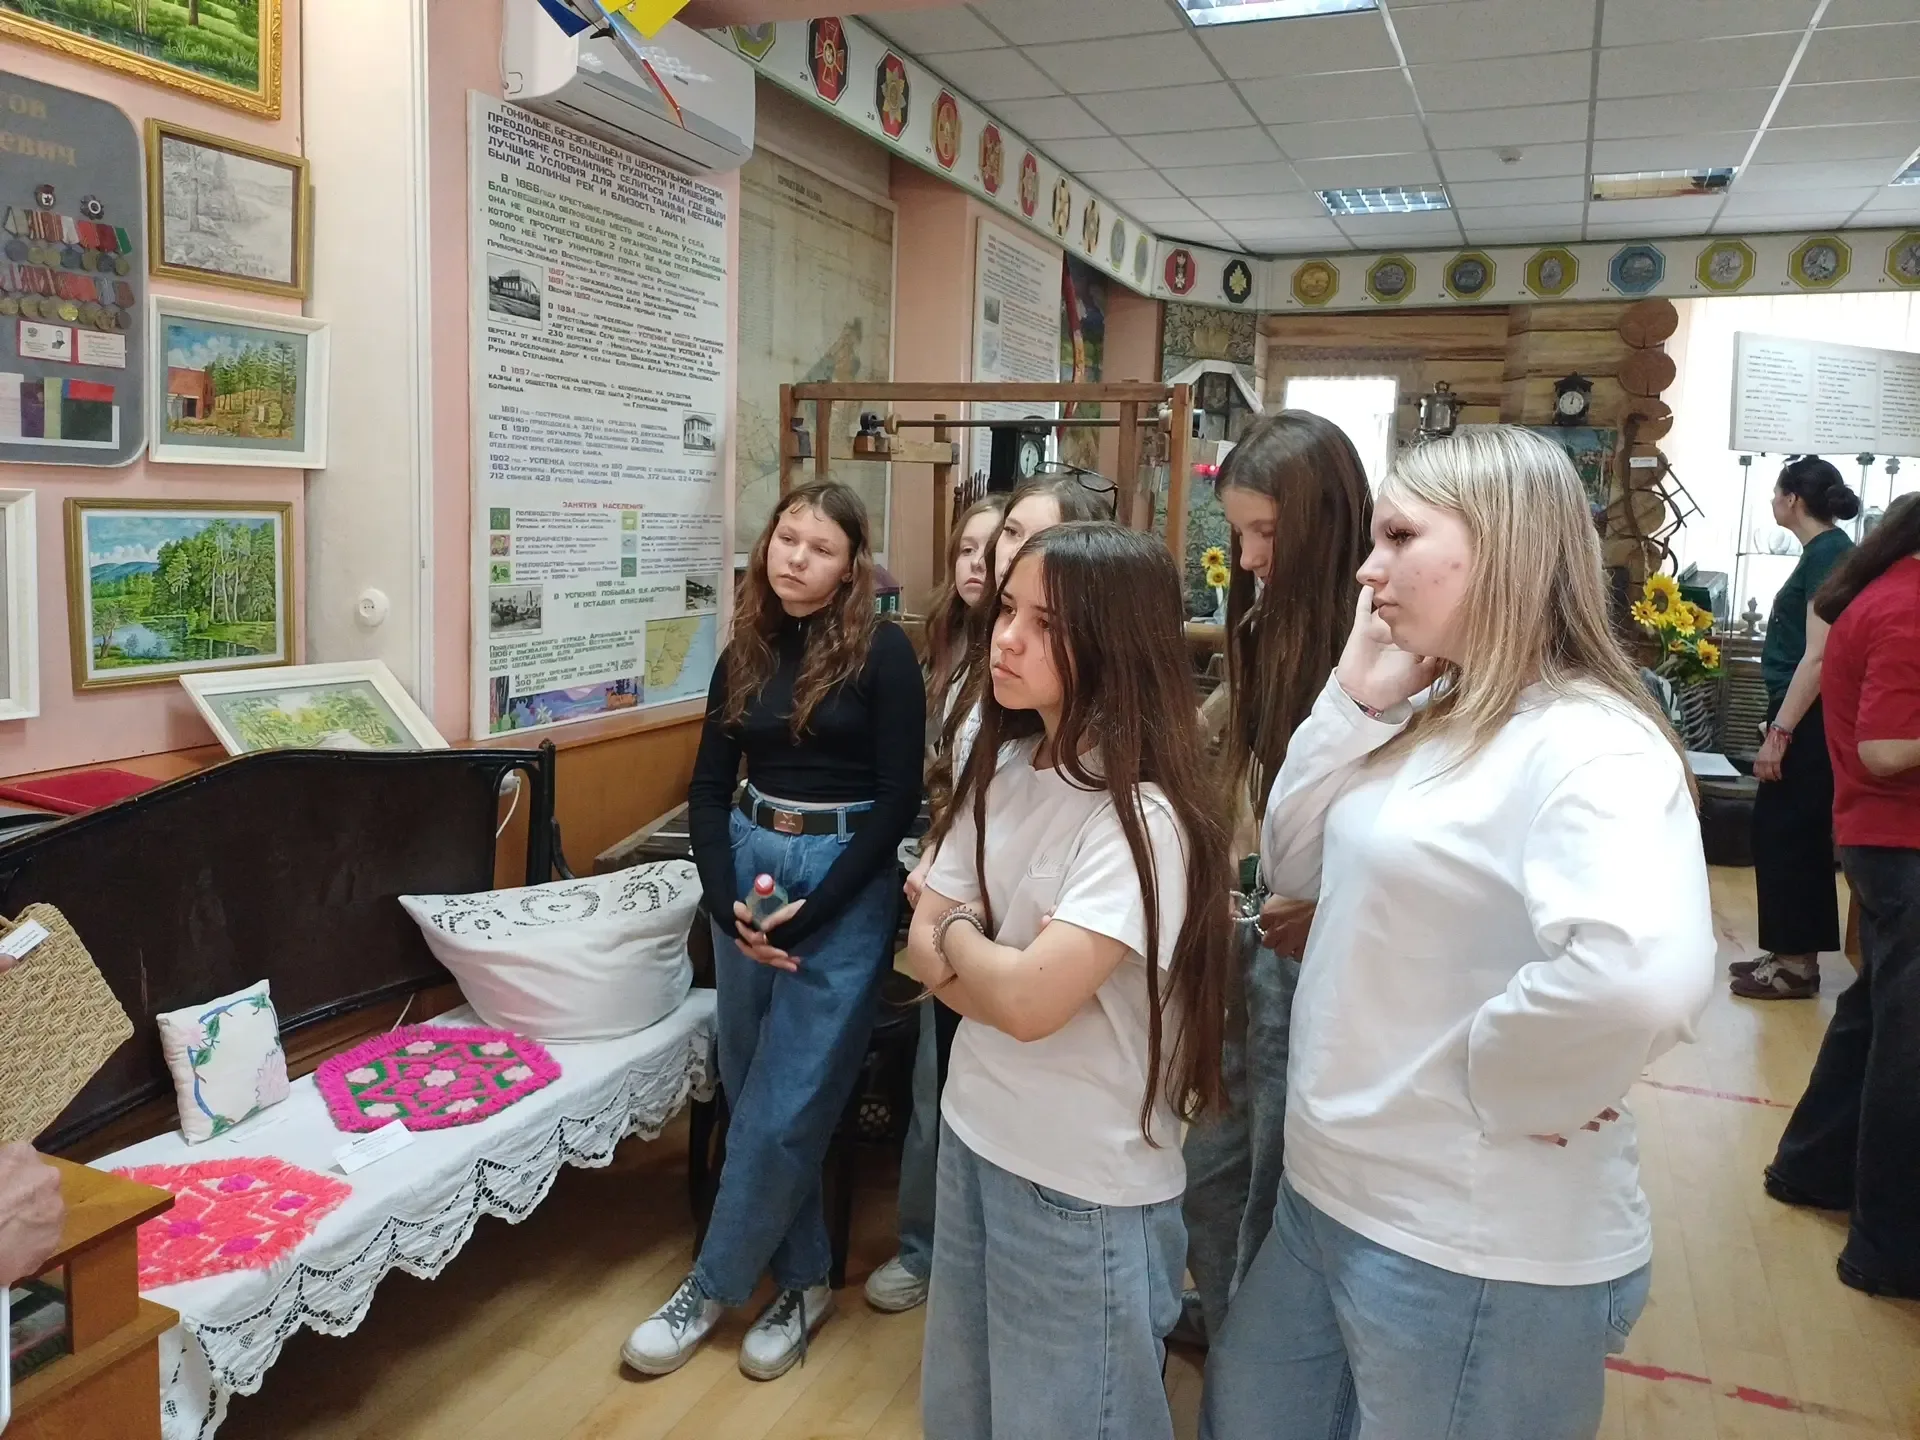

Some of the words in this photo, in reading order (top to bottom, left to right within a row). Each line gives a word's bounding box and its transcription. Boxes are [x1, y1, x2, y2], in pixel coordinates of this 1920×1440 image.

[487, 111, 564, 149] ПРЕОДОЛЕВАЯ
[569, 142, 613, 168] БОЛЬШИЕ
[618, 161, 666, 187] ТРУДНОСТИ
[669, 181, 675, 191] И
[500, 103, 553, 134] ГОНИМЫЕ,
[554, 125, 622, 161] БЕЗЗЕМЕЛЬЕМ
[487, 123, 549, 154] КРЕСТЬЯНЕ
[553, 148, 615, 179] СТРЕМИЛИСЬ
[620, 173, 663, 197] СЕЛИТЬСЯ
[688, 199, 702, 212] ГДЕ
[488, 147, 520, 167] БЫЛИ
[526, 161, 570, 184] ДОЛИНЫ
[576, 178, 594, 192] РЕК
[600, 186, 606, 196] И
[611, 190, 655, 213] БЛИЗОСТЬ
[488, 135, 534, 160] ЛУЧШИЕ
[540, 154, 585, 179] УСЛОВИЯ
[591, 173, 612, 188] ДЛЯ
[651, 195, 684, 214] ТАКИМИ
[687, 208, 722, 228] МЕСТАМИ
[501, 173, 508, 183] В
[487, 206, 524, 224] КОТОРОЕ
[529, 218, 604, 247] ПРОСУЩЕСТВОВАЛО
[608, 242, 614, 250] 2
[488, 195, 505, 206] ОНА
[511, 202, 520, 211] НЕ
[526, 207, 566, 225] ВЫХОДИТ
[488, 218, 515, 233] ОКОЛО
[543, 234, 563, 246] ТИГР
[568, 242, 613, 261] УНИЧТОЖИЛ
[547, 329, 563, 338] 230
[529, 457, 564, 465] УСПЕНКА
[583, 599, 615, 607] ОСТАВИЛ
